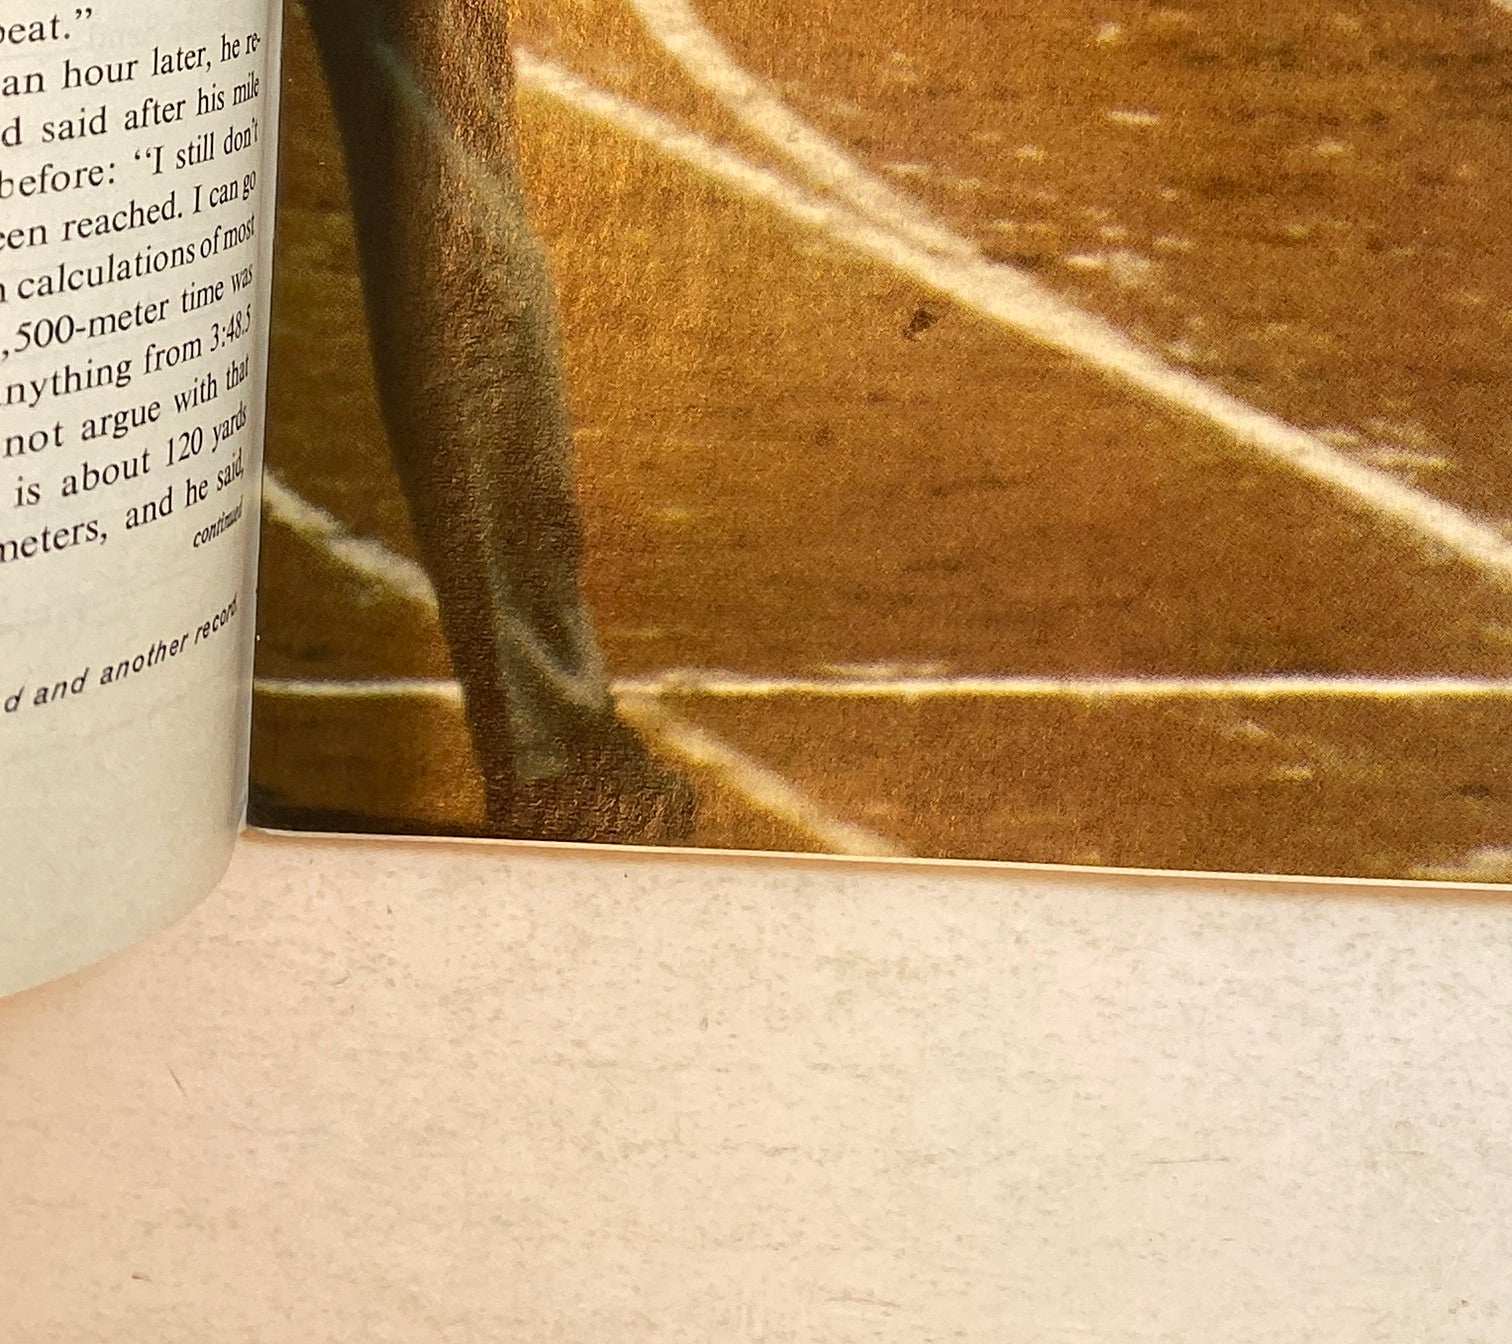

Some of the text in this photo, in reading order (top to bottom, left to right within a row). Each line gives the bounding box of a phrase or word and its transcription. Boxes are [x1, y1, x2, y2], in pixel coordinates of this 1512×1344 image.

[2, 31, 260, 97] an hour later, he re-
[41, 71, 259, 143] said after his mile
[0, 162, 114, 199] before:
[176, 132, 214, 169] still
[62, 170, 256, 242] reached. I can go
[17, 244, 195, 299] calculations
[200, 225, 221, 259] of
[223, 215, 255, 251] most
[181, 282, 224, 313] time
[231, 263, 253, 292] was
[143, 336, 202, 375] from
[3, 356, 249, 458] not argue with that
[15, 401, 247, 508] is about 120 yards
[125, 447, 244, 530] and he said,
[193, 496, 243, 549] continued
[33, 592, 238, 707] and another record
